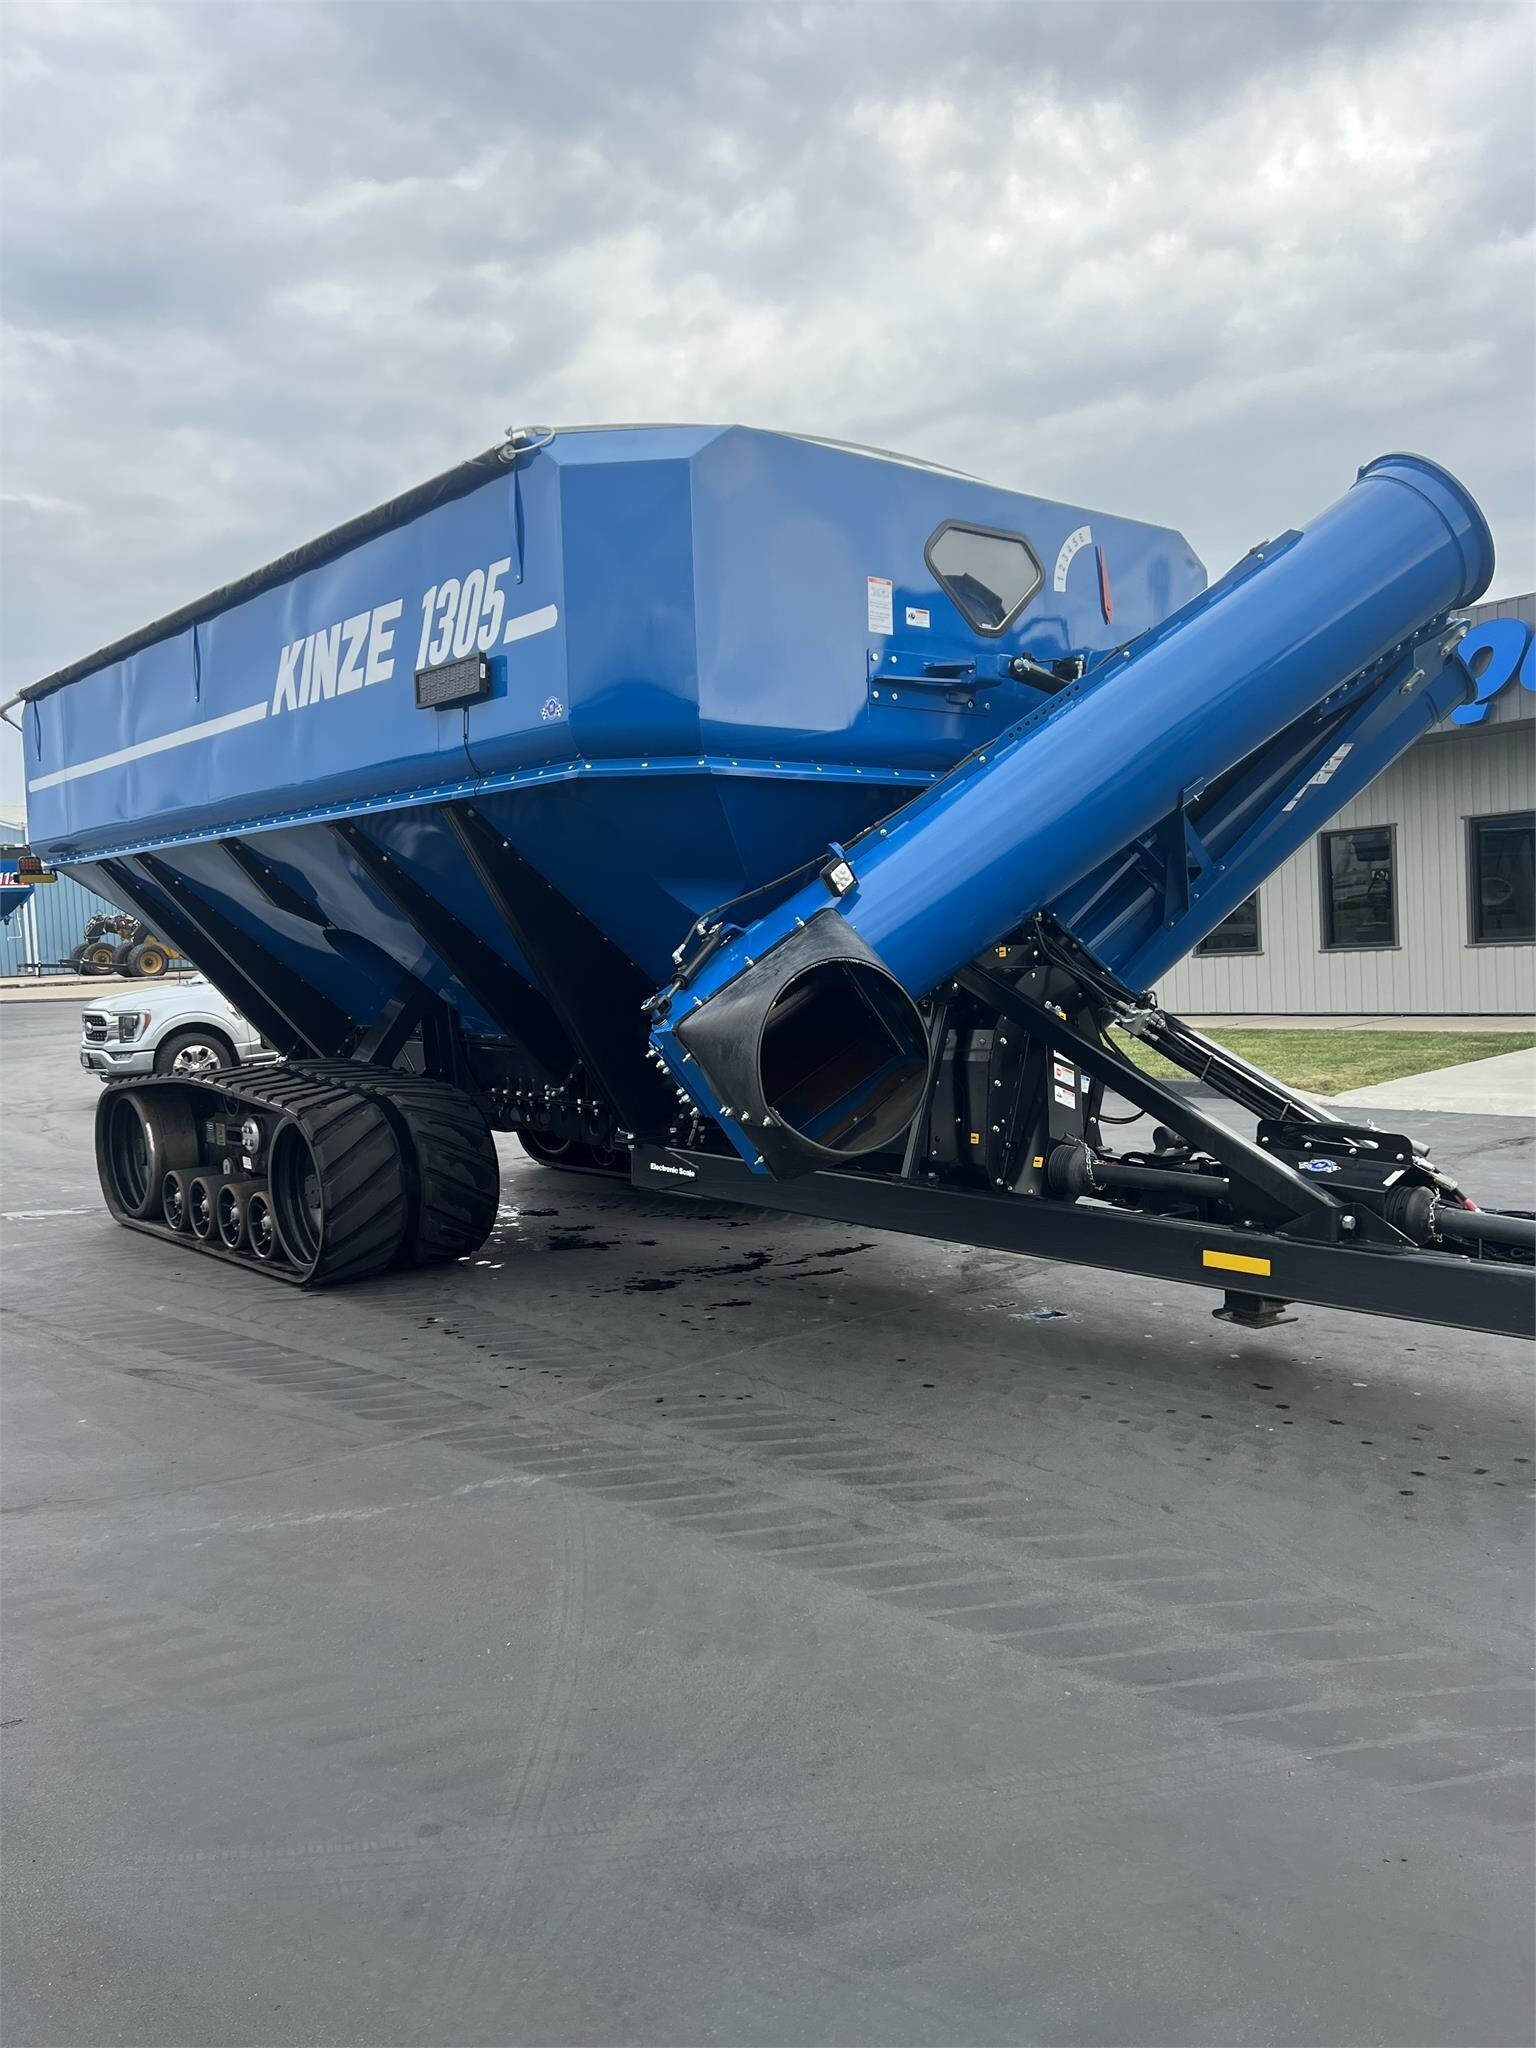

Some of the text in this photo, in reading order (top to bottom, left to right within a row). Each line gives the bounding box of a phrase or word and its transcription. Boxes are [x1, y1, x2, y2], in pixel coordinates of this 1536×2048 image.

[272, 557, 511, 716] KINZE 1305
[650, 1162, 695, 1177] Electronic Scale
